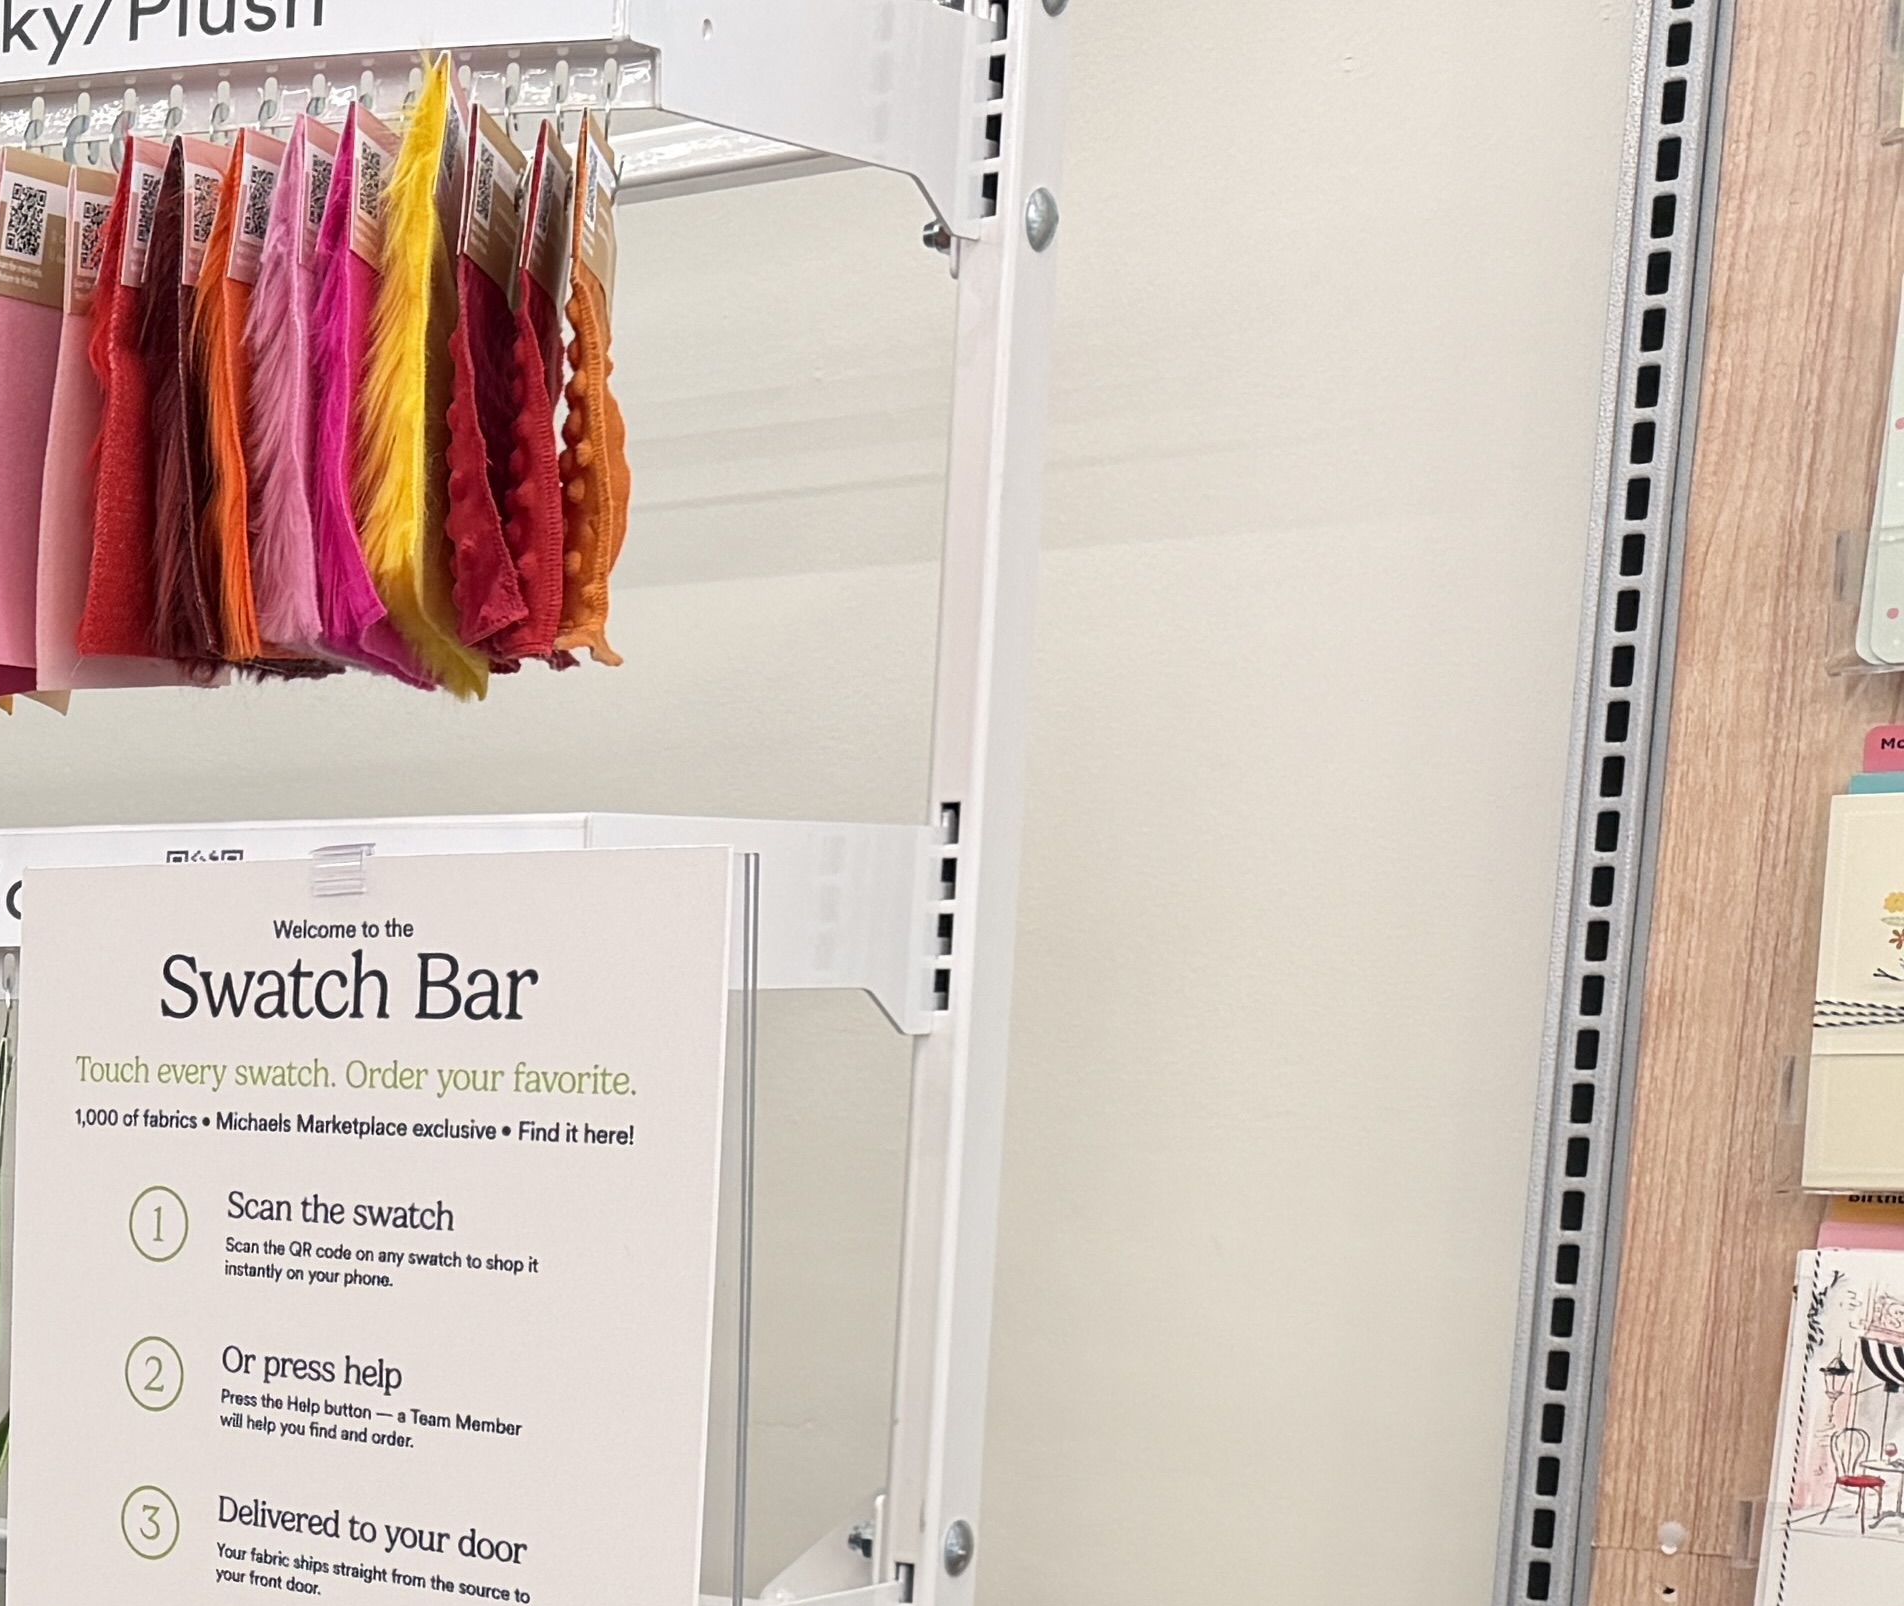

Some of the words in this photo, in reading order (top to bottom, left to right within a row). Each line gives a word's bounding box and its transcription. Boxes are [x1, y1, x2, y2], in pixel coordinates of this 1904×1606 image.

[272, 919, 357, 940] Welcome
[384, 917, 414, 938] the
[160, 948, 390, 1020] Swatch
[414, 952, 539, 1021] Bar
[75, 1055, 150, 1084] Touch
[157, 1063, 228, 1093] every
[234, 1057, 336, 1088] swatch.
[345, 1059, 429, 1090] Order
[436, 1068, 505, 1099] your
[513, 1061, 637, 1096] favorite.
[75, 1108, 119, 1128] 1,000
[142, 1108, 198, 1130] fabrics
[216, 1111, 292, 1133] Michaels
[296, 1113, 408, 1140] Marketplace
[412, 1117, 497, 1141] exclusive
[518, 1120, 560, 1143] Find
[583, 1122, 635, 1146] here!
[227, 1190, 292, 1222] Scan
[300, 1193, 345, 1225] the
[352, 1199, 455, 1232] swatch
[224, 1259, 283, 1283] instantly
[307, 1270, 341, 1286] your
[343, 1268, 394, 1288] phone.
[225, 1236, 260, 1255] Scan
[315, 1243, 352, 1261] code
[377, 1250, 405, 1268] any
[407, 1251, 462, 1268] swatch
[485, 1253, 525, 1276] shop
[263, 1355, 336, 1384] press
[343, 1354, 403, 1397] help
[219, 1412, 243, 1429] will
[246, 1414, 277, 1436] help
[308, 1421, 338, 1440] find
[371, 1430, 414, 1449] order.
[220, 1388, 258, 1408] Press
[287, 1395, 321, 1417] Help
[324, 1399, 372, 1421] button
[409, 1408, 451, 1429] Team
[455, 1413, 523, 1436] Member
[218, 1495, 341, 1539] Delivered
[384, 1524, 451, 1554] your
[457, 1527, 528, 1565] door
[215, 1568, 246, 1583] your
[249, 1570, 283, 1590] front
[285, 1575, 321, 1596] door.
[216, 1541, 248, 1561] Your
[250, 1547, 290, 1568] fabric
[293, 1554, 330, 1575] ships
[332, 1562, 388, 1584] straight
[391, 1568, 426, 1589] from
[458, 1582, 511, 1602] source
